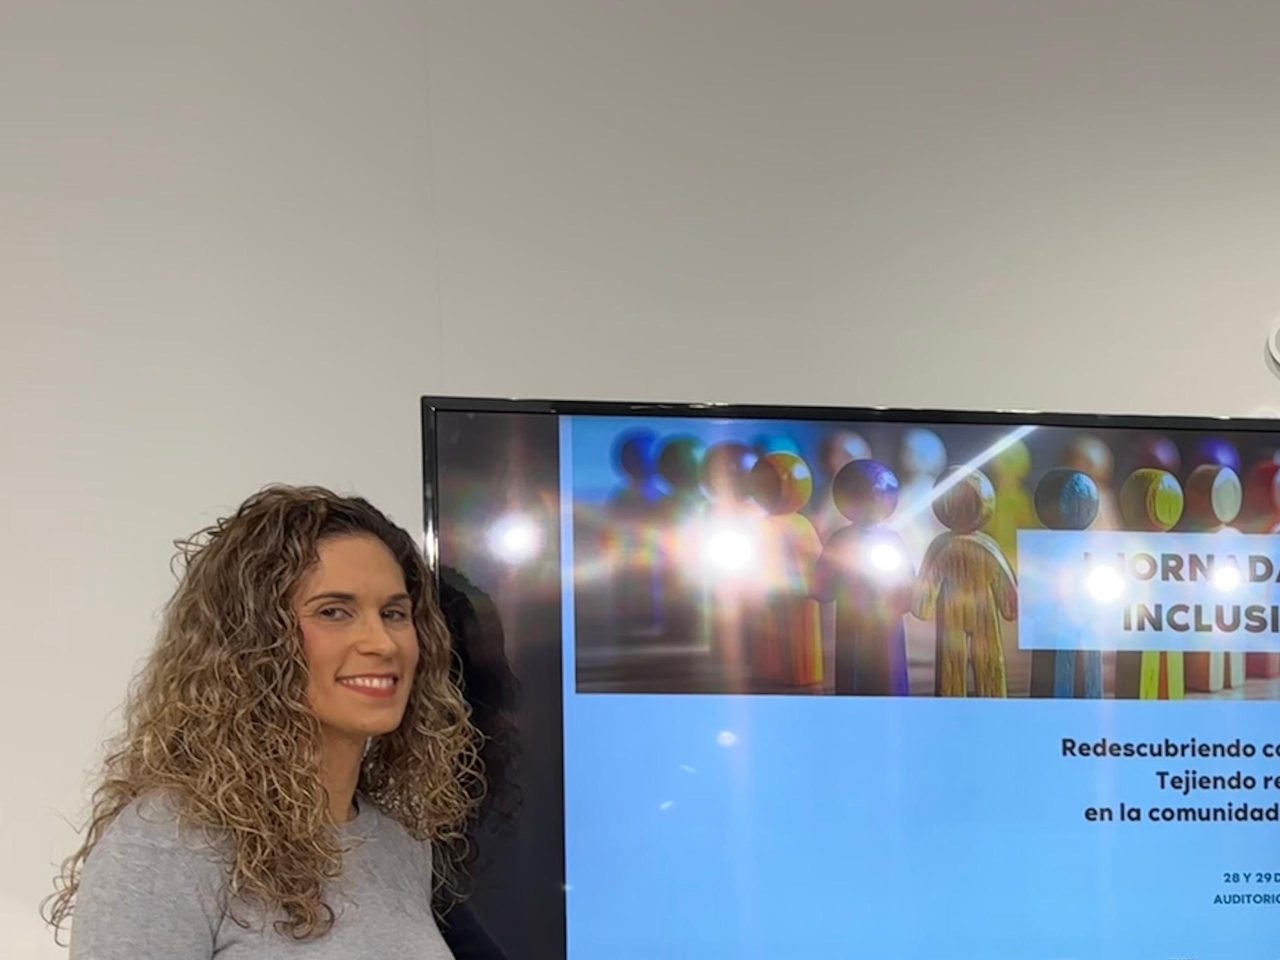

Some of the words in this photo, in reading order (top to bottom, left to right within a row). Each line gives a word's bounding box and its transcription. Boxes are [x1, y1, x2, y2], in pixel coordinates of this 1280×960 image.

[1061, 738, 1257, 758] Redescubriendo
[1156, 770, 1257, 795] Tejiendo
[1084, 807, 1113, 822] en
[1119, 803, 1142, 822] la
[1147, 802, 1280, 822] comunidad
[1223, 872, 1241, 883] 28
[1243, 872, 1252, 883] Y
[1255, 872, 1273, 883] 29
